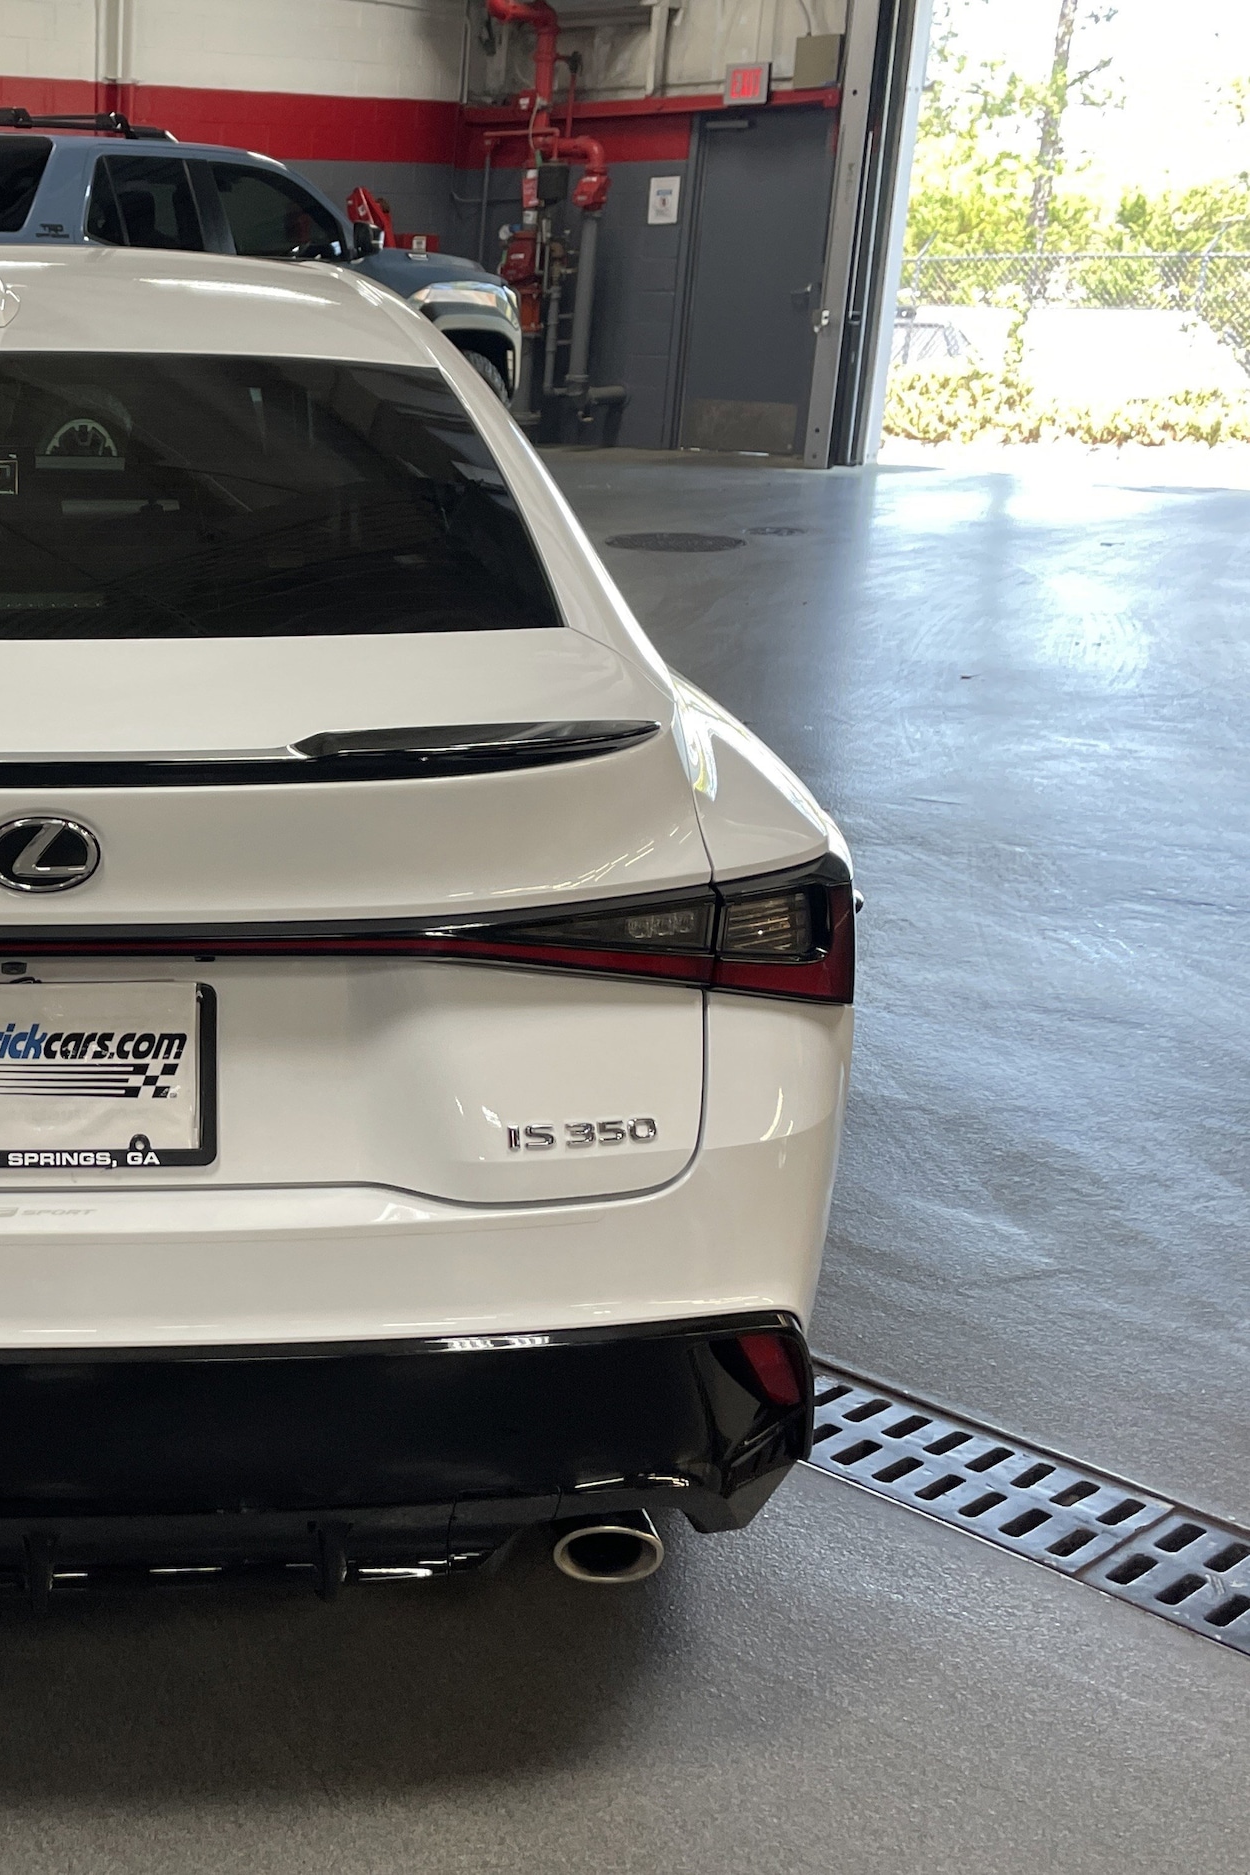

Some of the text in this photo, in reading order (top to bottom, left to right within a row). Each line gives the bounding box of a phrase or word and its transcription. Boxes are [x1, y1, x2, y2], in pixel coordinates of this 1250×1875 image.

[730, 67, 763, 99] EXIT
[506, 1118, 658, 1151] IS 350
[8, 1151, 118, 1168] SPRINGS,
[126, 1151, 161, 1167] GA
[21, 1208, 98, 1216] SPORT
